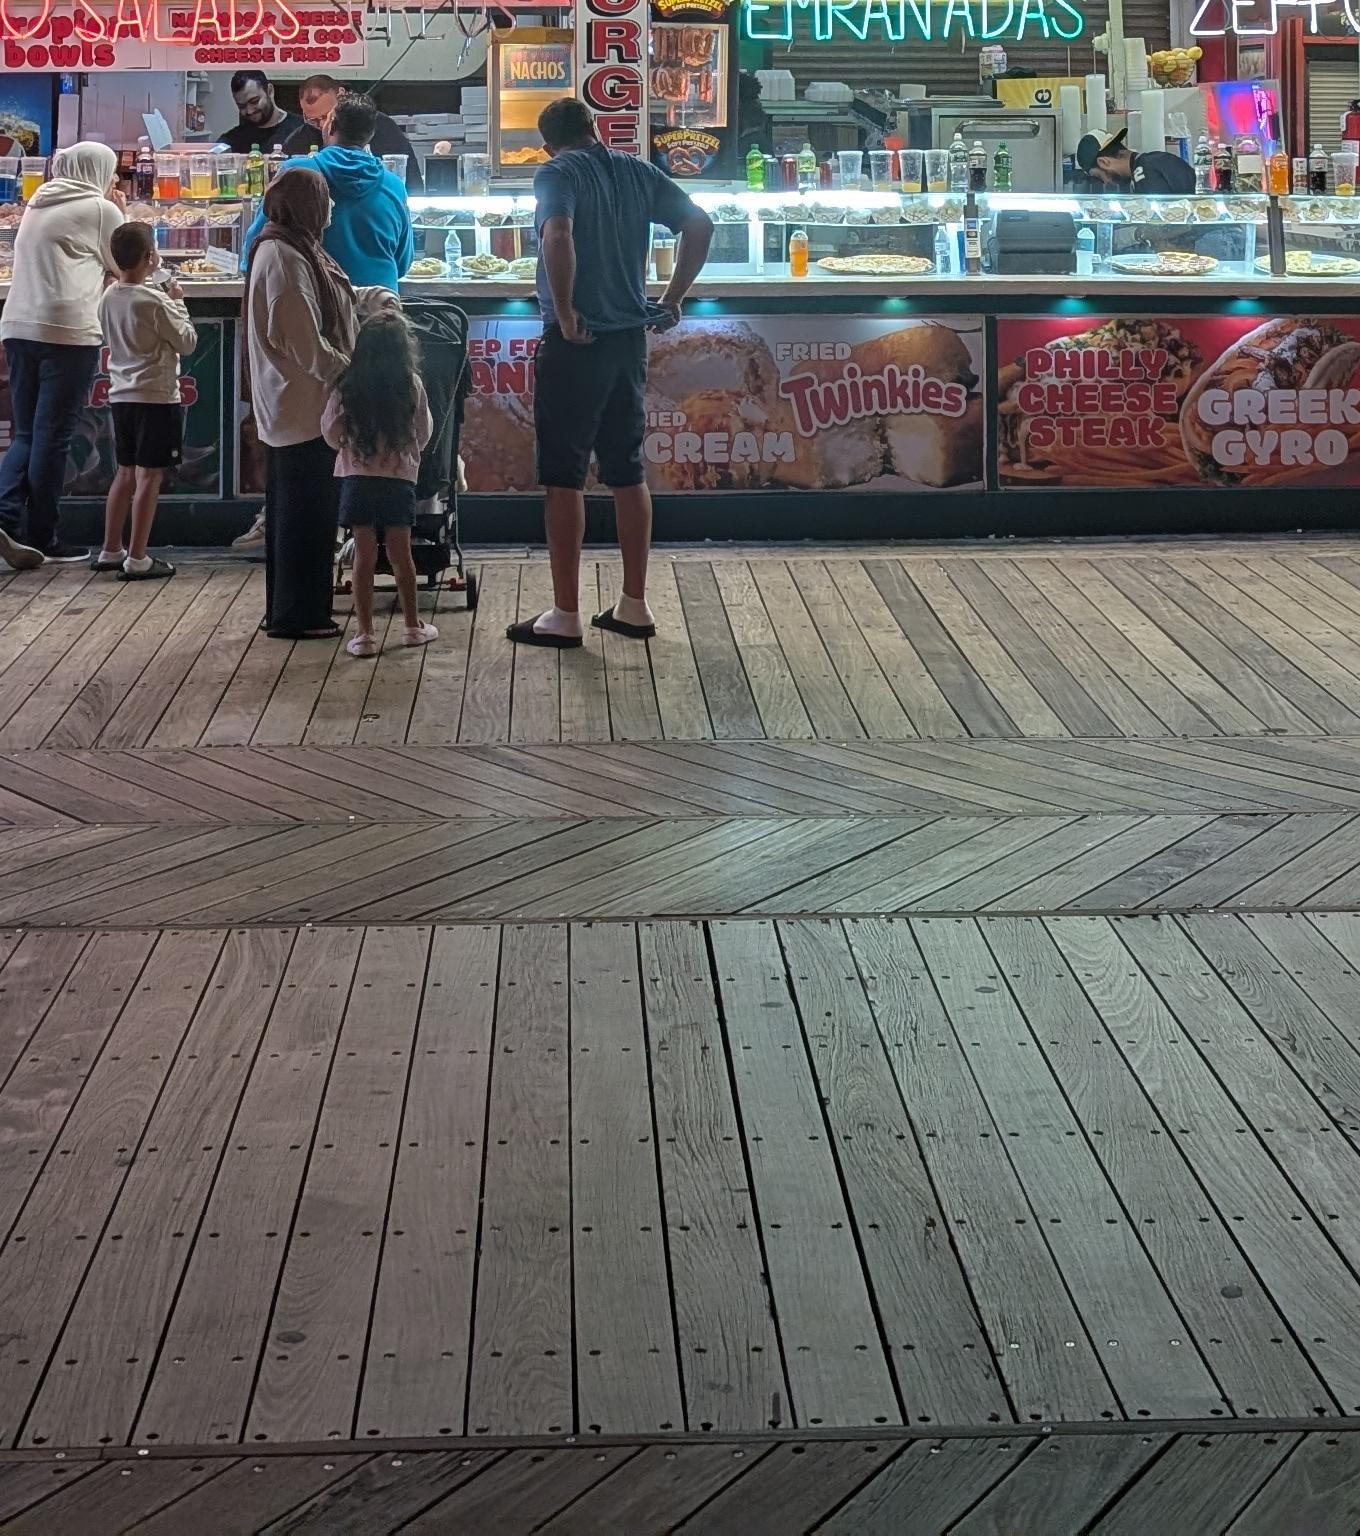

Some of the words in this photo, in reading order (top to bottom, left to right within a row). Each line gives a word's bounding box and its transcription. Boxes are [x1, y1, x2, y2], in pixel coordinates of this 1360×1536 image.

[313, 28, 358, 45] COB
[4, 39, 116, 68] bowls
[194, 47, 276, 64] CHEESE
[280, 46, 341, 64] FRIES
[510, 61, 566, 80] NACHOS
[468, 338, 502, 357] EP
[775, 342, 852, 362] FRIED
[1025, 349, 1169, 380] PHILLY
[780, 365, 967, 438] Twinkies
[1018, 382, 1178, 415] CHEESE
[648, 411, 687, 428] IED
[1028, 416, 1168, 449] STEAK
[1211, 428, 1351, 467] GYRO
